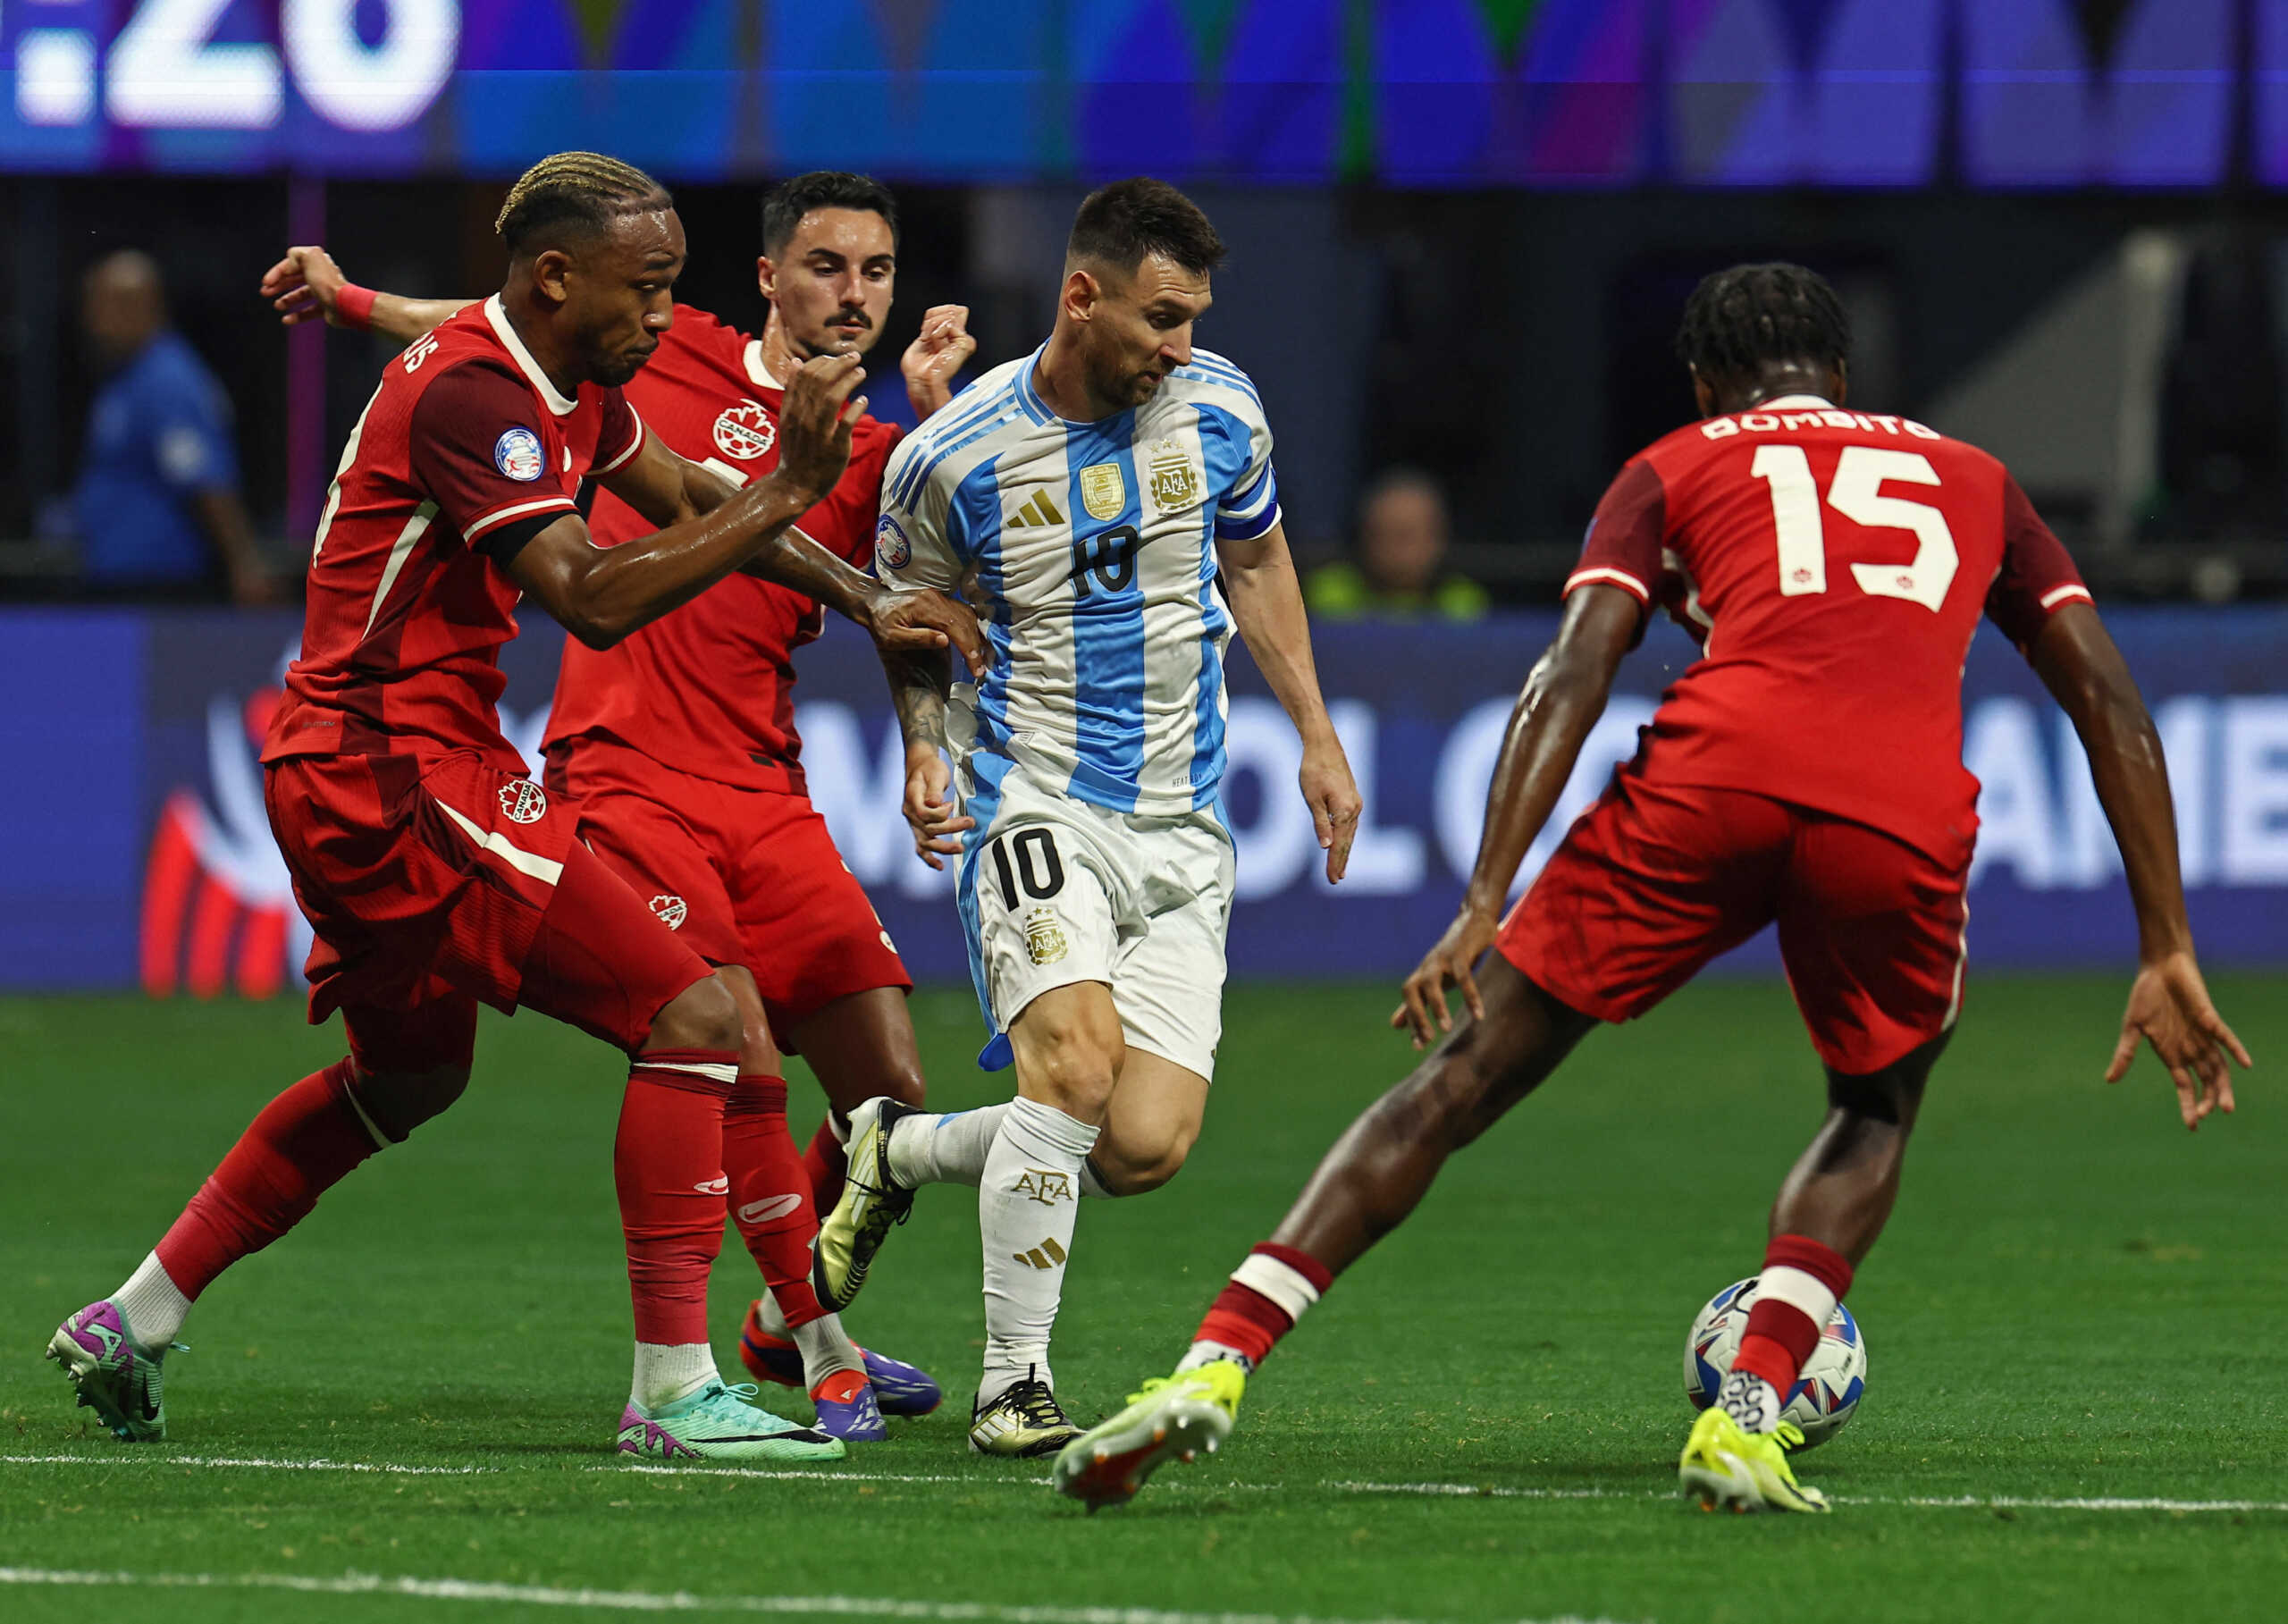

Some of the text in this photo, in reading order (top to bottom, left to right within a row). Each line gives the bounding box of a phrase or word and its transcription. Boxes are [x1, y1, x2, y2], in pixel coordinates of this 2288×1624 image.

[718, 418, 769, 447] CANADA
[1700, 410, 1942, 441] BOMBITO
[1161, 468, 1190, 497] AFA
[1750, 444, 1960, 614] 15
[514, 784, 532, 820] CANADA
[992, 828, 1065, 913] 10
[1010, 1166, 1074, 1207] AFA
